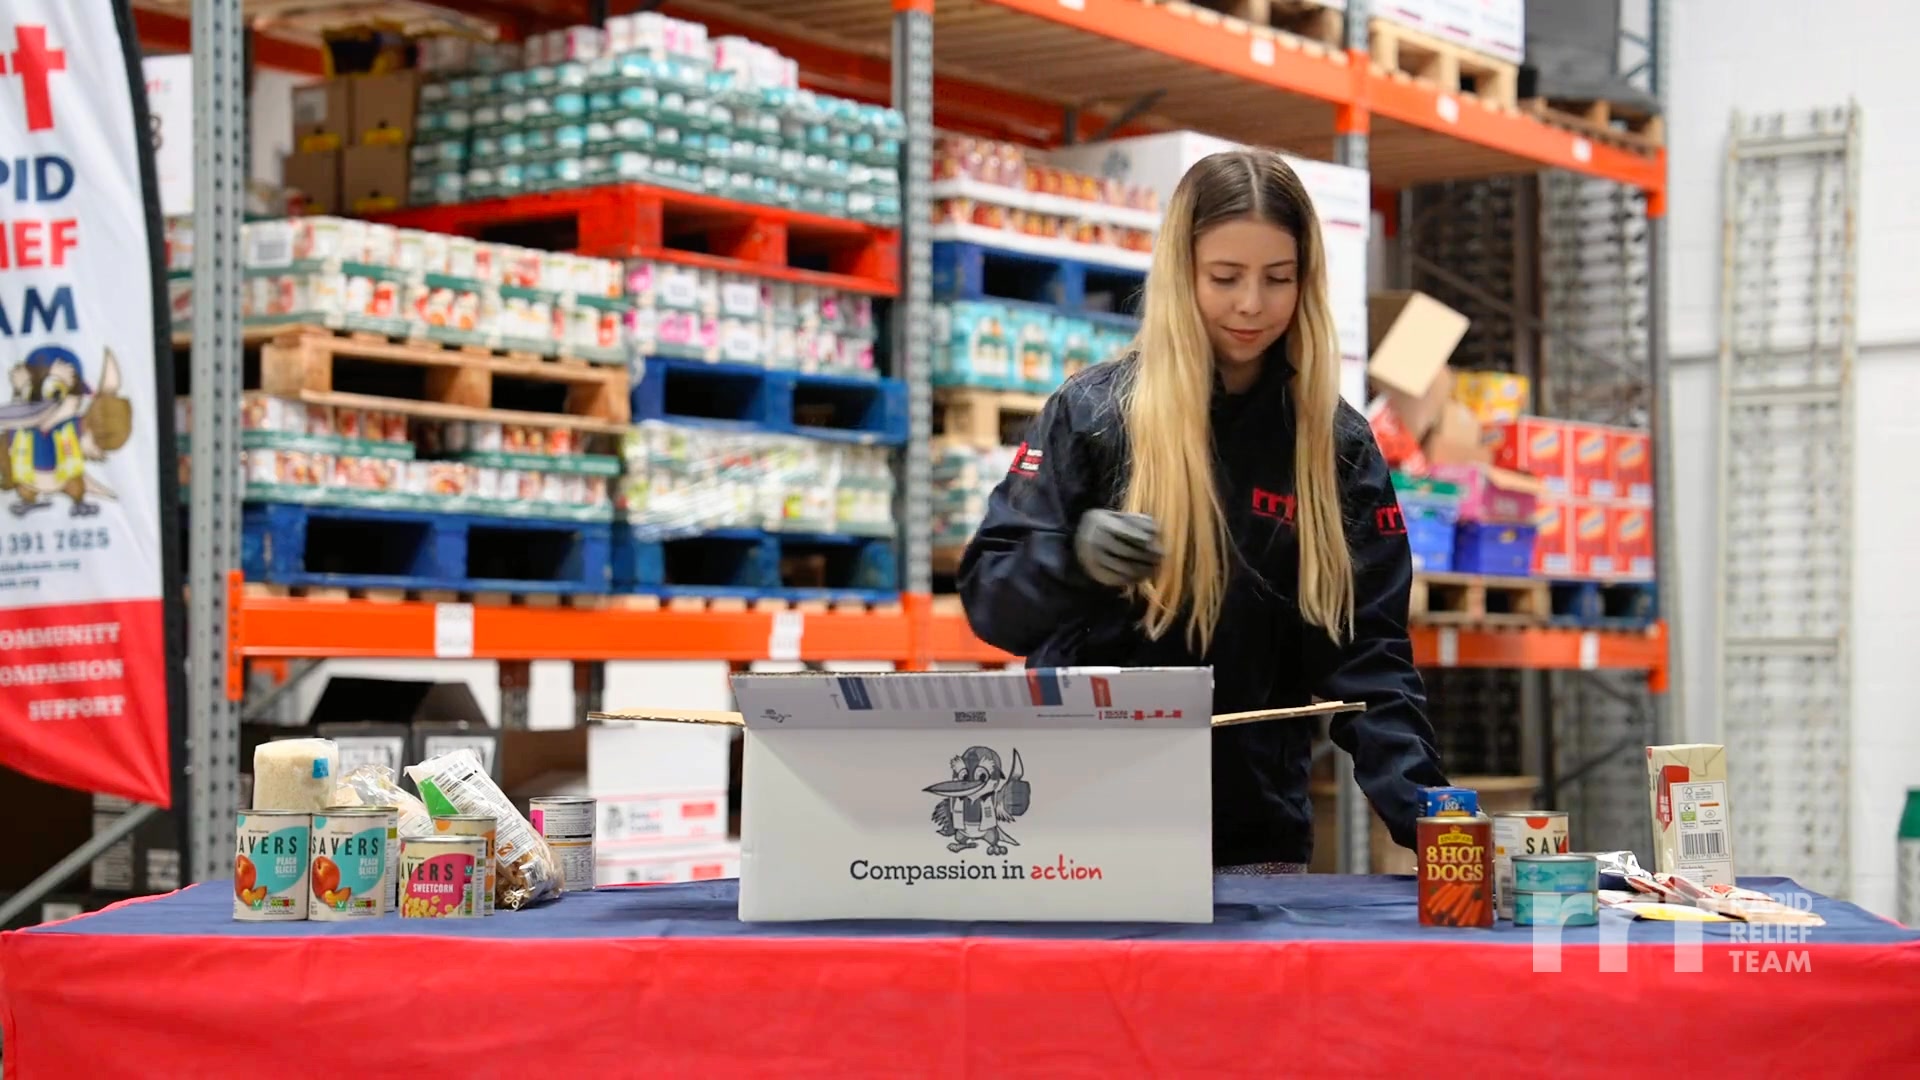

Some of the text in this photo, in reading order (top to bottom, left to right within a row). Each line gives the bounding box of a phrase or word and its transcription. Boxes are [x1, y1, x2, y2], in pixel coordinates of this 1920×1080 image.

[28, 695, 125, 721] SUPPORT
[276, 857, 297, 865] PEACH
[1426, 846, 1484, 863] 8 HOT
[360, 858, 378, 866] PEACH
[275, 865, 297, 875] SLICES
[850, 854, 1103, 885] Compassion in action
[1426, 864, 1484, 882] DOGS
[412, 883, 454, 894] SWEETCORN
